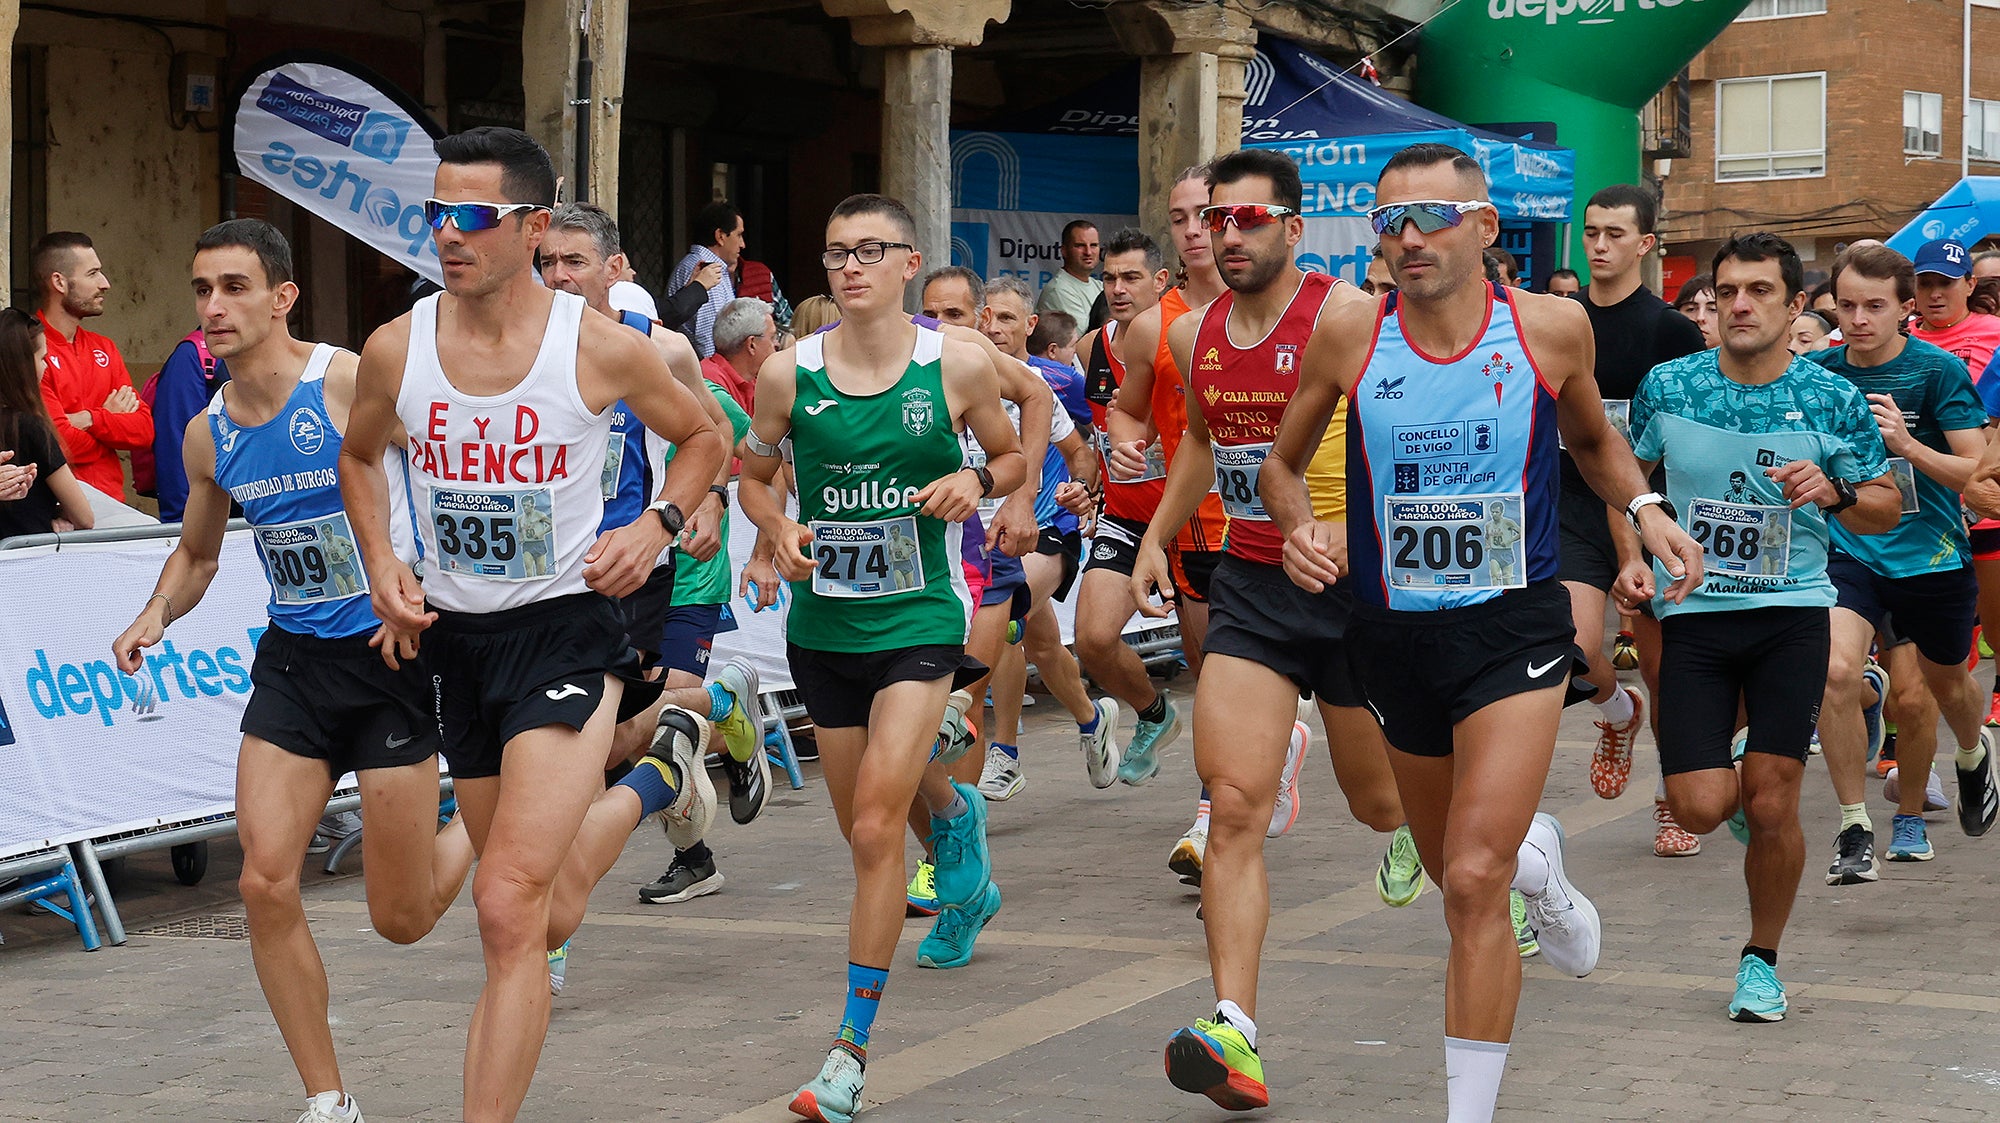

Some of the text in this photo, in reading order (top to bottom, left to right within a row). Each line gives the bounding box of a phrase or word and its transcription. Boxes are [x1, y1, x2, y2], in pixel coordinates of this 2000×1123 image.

[1223, 391, 1288, 403] CAJA RURAL
[428, 402, 449, 441] E
[514, 405, 540, 445] D
[1224, 411, 1269, 425] VINO
[1217, 426, 1238, 439] DE
[1398, 428, 1459, 442] CONCELLO
[1405, 441, 1453, 455] DE VIGO
[410, 436, 568, 484] PALENCIA
[1423, 462, 1469, 475] XUNTA
[282, 474, 295, 492] DE
[294, 467, 337, 490] BURGOS
[1423, 471, 1496, 487] DE GALICIA
[452, 494, 491, 505] 10.000
[823, 478, 920, 513] gullón
[439, 501, 480, 511] MARIANO
[1414, 504, 1458, 514] 10.000
[1398, 511, 1477, 520] MARIANO HARO
[436, 513, 516, 561] 335
[1692, 520, 1760, 560] 268
[1393, 525, 1483, 570] 206
[269, 546, 328, 587] 309
[817, 545, 889, 580] 274
[26, 641, 251, 727] deportes
